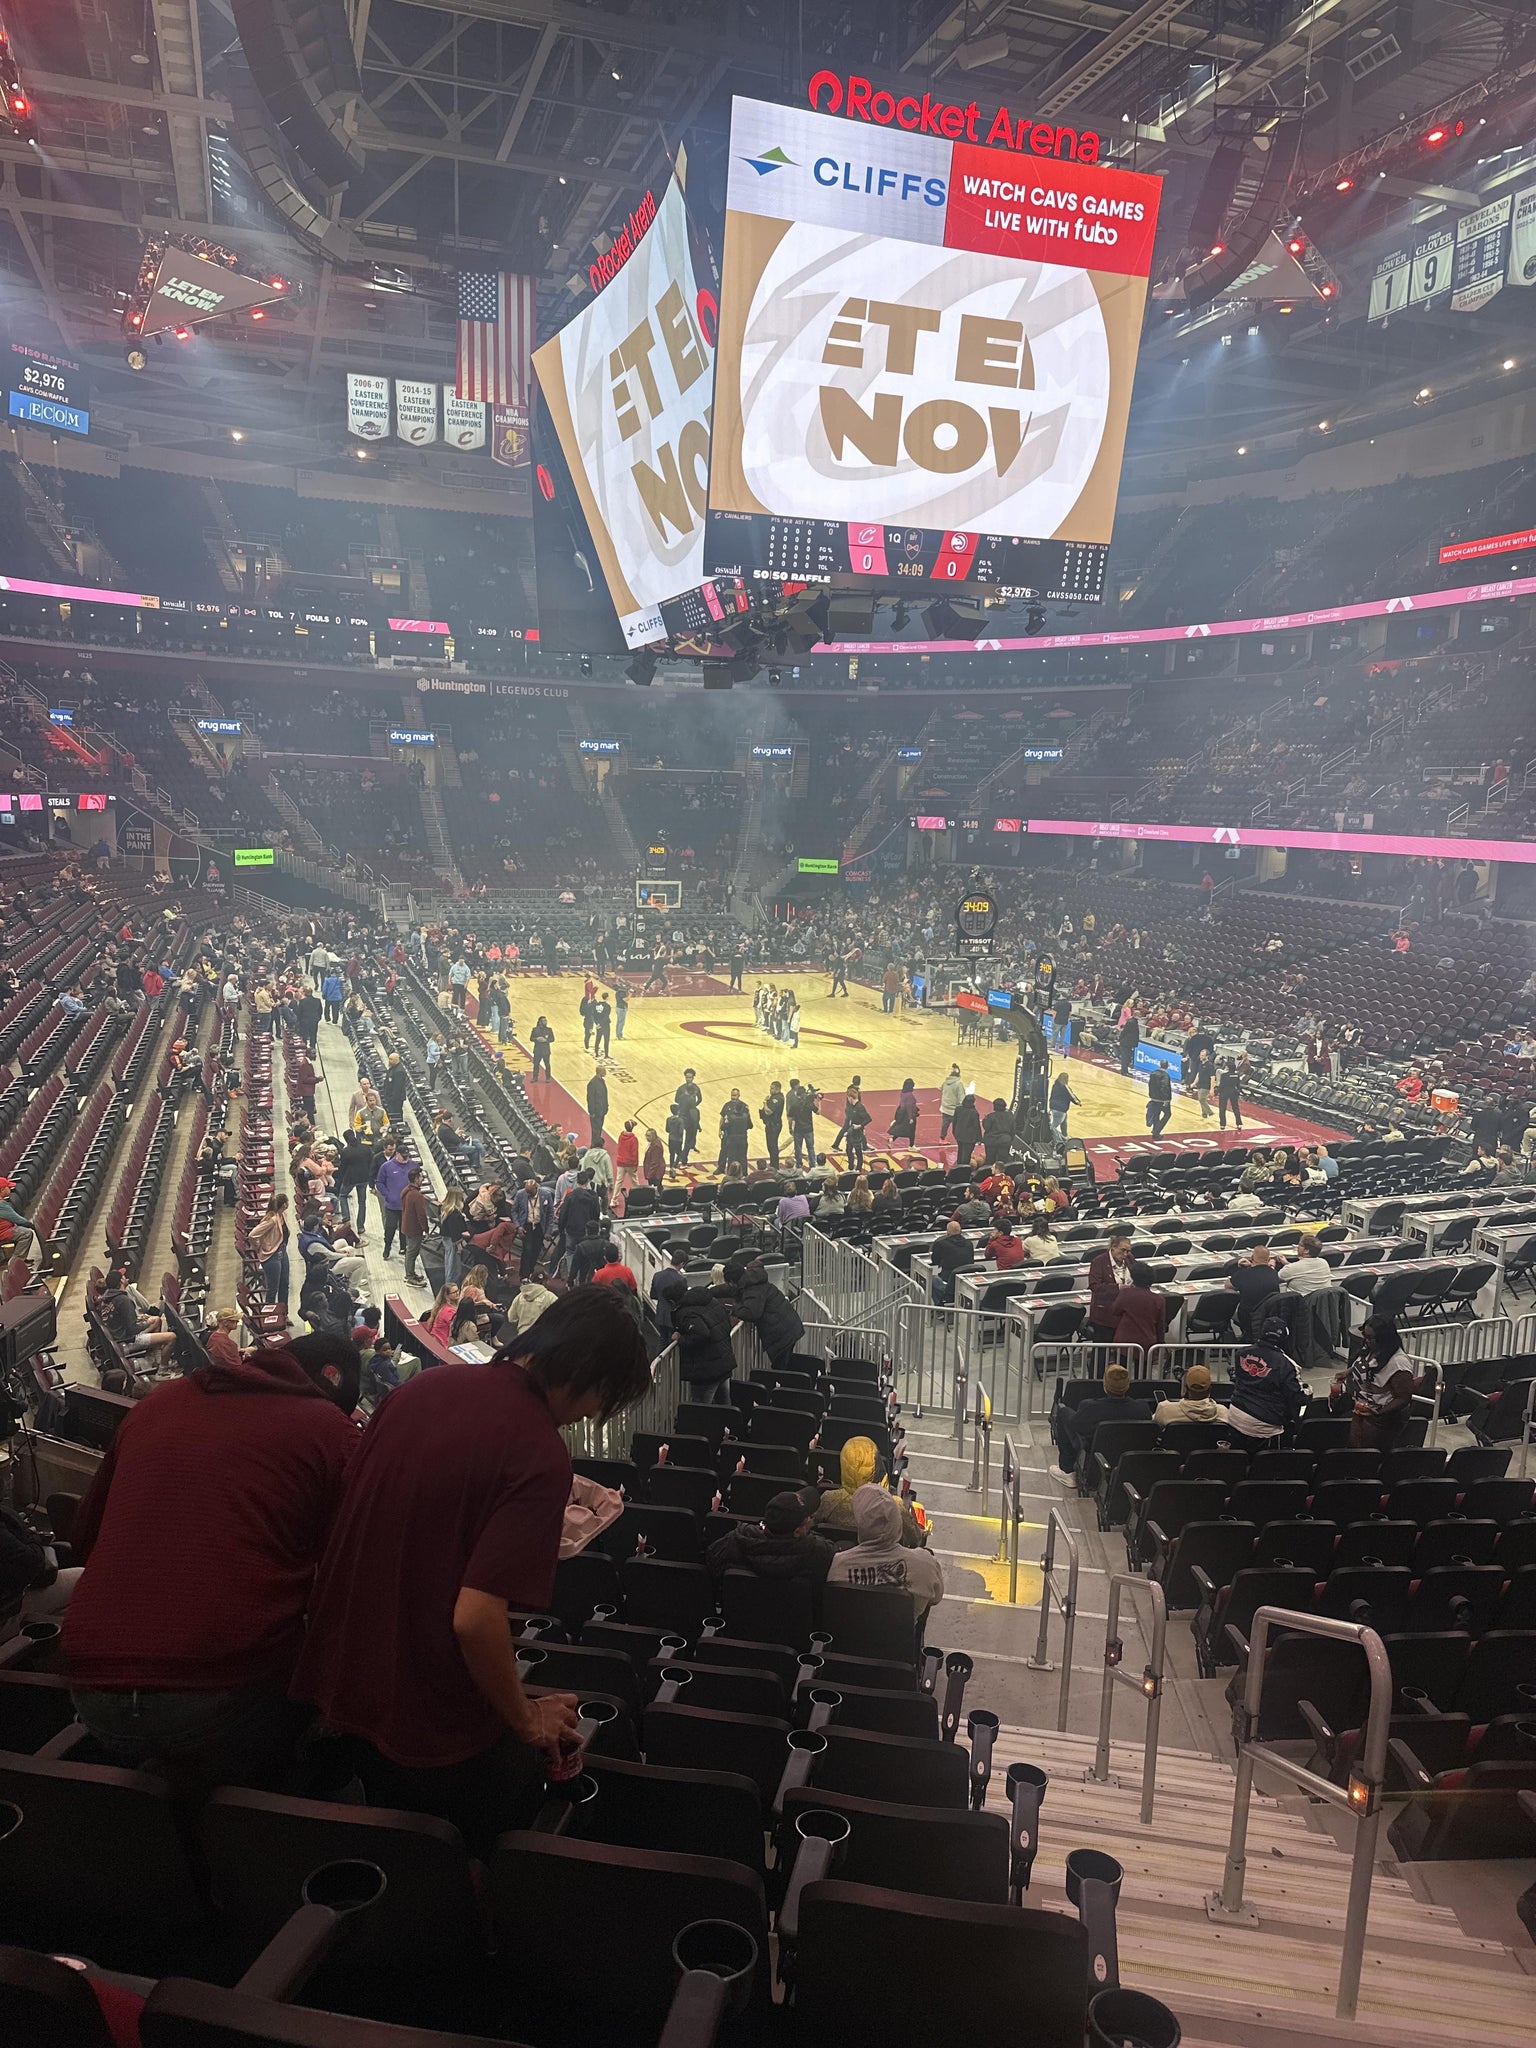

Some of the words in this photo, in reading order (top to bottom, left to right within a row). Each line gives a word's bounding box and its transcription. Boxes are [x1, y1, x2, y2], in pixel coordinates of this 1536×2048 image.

[848, 76, 981, 142] Rocket
[987, 108, 1100, 162] Arena
[814, 157, 946, 207] CLIFFS
[963, 174, 1026, 203] WATCH
[1029, 185, 1079, 212] CAVS
[1082, 195, 1145, 223] GAMES
[1459, 200, 1509, 229] CLEVELAND
[985, 208, 1021, 232] LIVE
[1027, 215, 1070, 240] WITH
[1074, 222, 1119, 246] fubo
[597, 224, 634, 282] Rocket
[629, 190, 657, 242] Arena
[1416, 233, 1452, 256] GLOVER
[1377, 254, 1406, 273] BOWER
[1424, 256, 1438, 292] 9
[167, 277, 200, 292] LET
[200, 288, 224, 303] EM
[1384, 274, 1393, 310] 1
[157, 286, 217, 312] KNOW.
[41, 353, 80, 371] RAFFLE
[24, 367, 65, 390] $2,976
[354, 379, 384, 389] 2006-07
[19, 384, 69, 403] CAVS.COM/RAFFLE
[355, 390, 383, 400] EASTERN
[402, 385, 431, 395] 2014-15
[350, 399, 389, 410] CONFERENCE
[403, 396, 430, 405] EASTERN
[451, 400, 478, 409] EASTERN
[352, 408, 387, 419] CHAMPIONS
[399, 404, 436, 415] CONFERENCE
[447, 408, 483, 419] CONFERENCE
[400, 413, 434, 424] CHAMPIONS
[448, 418, 481, 428] CHAMPIONS
[495, 415, 529, 426] CHAMPIONS
[889, 533, 901, 543] 1Q
[1443, 550, 1462, 558] WATCH
[1462, 546, 1478, 555] CAVS
[1478, 542, 1498, 551] GAMES
[1512, 536, 1528, 545] WITH
[863, 554, 872, 570] 0
[715, 565, 741, 575] oswald
[898, 563, 923, 576] 34:09
[947, 562, 956, 577] 0
[791, 574, 831, 583] RAFFLE
[1000, 586, 1031, 598] $2,976
[1047, 591, 1100, 601] CAVS5050.COM
[196, 604, 220, 613] $2,976
[268, 611, 283, 619] TOL
[306, 614, 329, 623] FOULS
[335, 616, 341, 625] 0
[429, 624, 435, 632] 0
[638, 616, 663, 633] CLIFFS
[477, 628, 497, 636] 34:09
[510, 630, 522, 639] 1Q
[431, 679, 486, 695] Huntington
[496, 686, 541, 696] LEGENDS
[544, 687, 569, 698] CLUB
[197, 719, 218, 732] drug
[220, 722, 240, 731] mart
[390, 731, 411, 742] drug
[412, 733, 434, 742] mart
[579, 740, 599, 751] drug
[600, 741, 619, 750] mart
[753, 746, 771, 757] drug
[772, 747, 791, 756] mart
[1024, 748, 1042, 759] drug
[1044, 749, 1063, 758] mart
[48, 798, 70, 806] STEALS
[938, 819, 944, 827] 0
[126, 832, 134, 840] IN
[135, 832, 151, 841] THE
[126, 841, 151, 850] PAINT
[963, 902, 988, 912] 34:09
